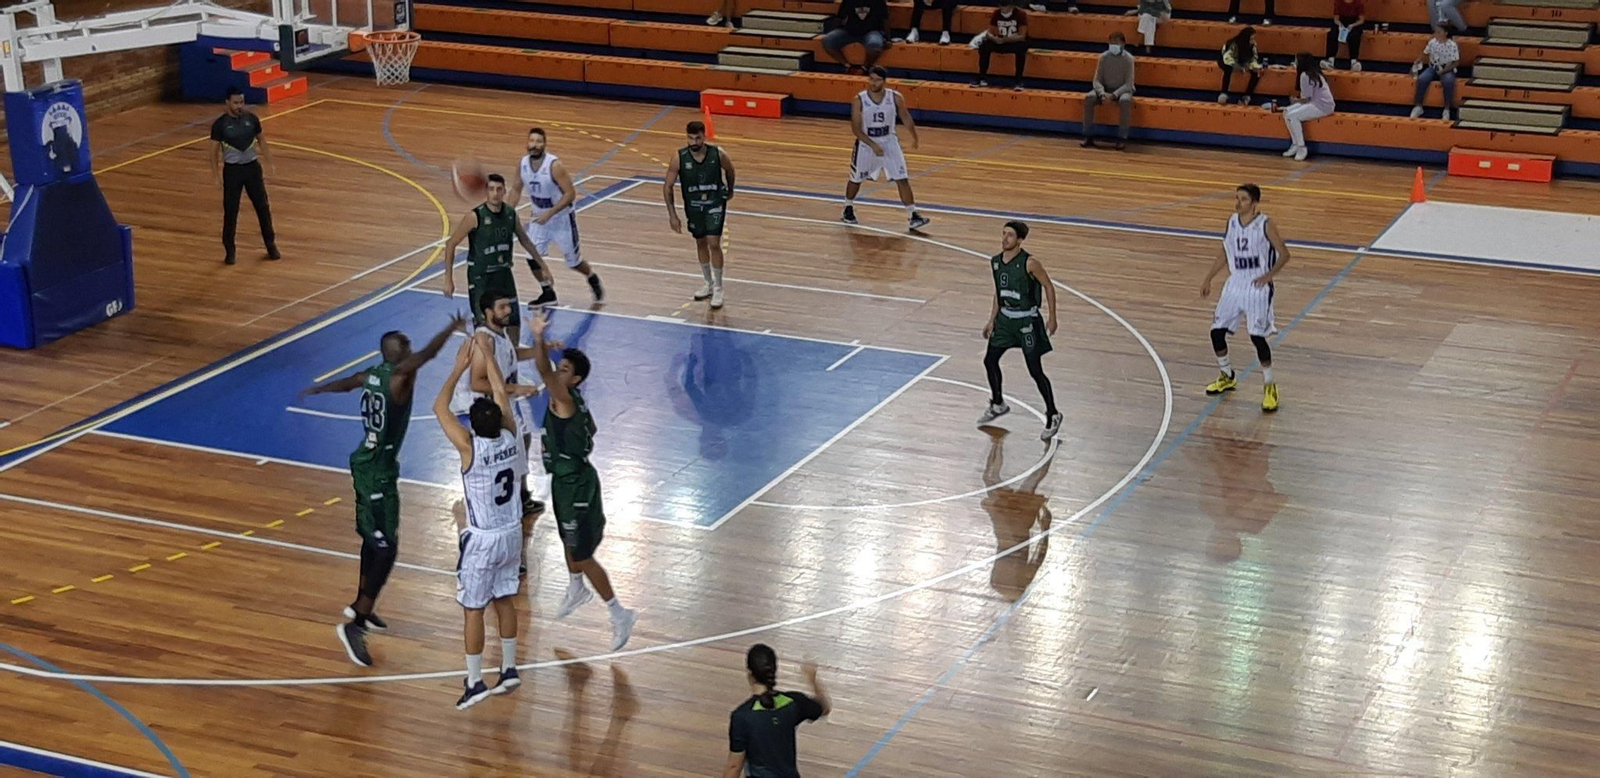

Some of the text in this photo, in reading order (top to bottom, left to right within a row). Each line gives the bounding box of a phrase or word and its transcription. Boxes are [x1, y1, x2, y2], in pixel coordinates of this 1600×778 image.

[872, 111, 885, 123] 19
[1236, 237, 1249, 252] 12
[1000, 272, 1009, 287] 9
[1024, 333, 1034, 347] 9
[360, 388, 386, 433] 48
[482, 455, 493, 466] V.
[494, 467, 515, 507] 3
